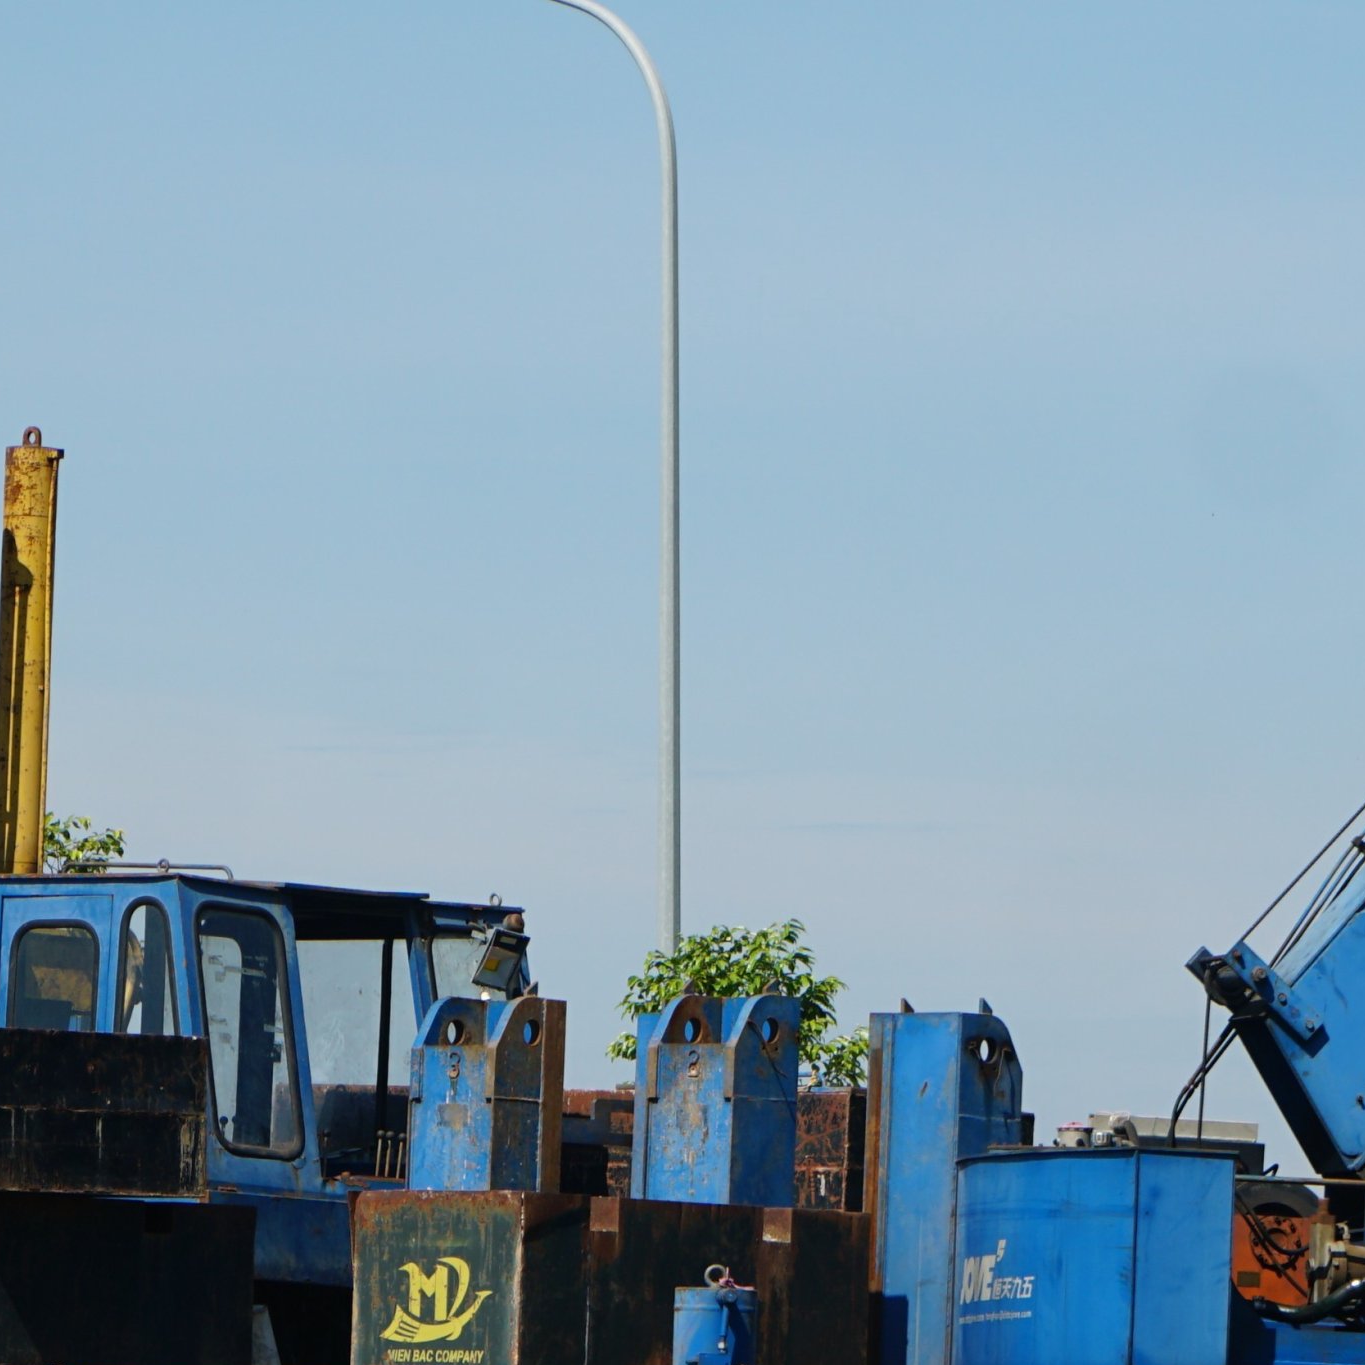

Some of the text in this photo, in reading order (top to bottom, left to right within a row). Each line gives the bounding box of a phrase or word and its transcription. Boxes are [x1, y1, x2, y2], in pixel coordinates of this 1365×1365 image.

[387, 1348, 484, 1364] MIEN BAC COMPANY
